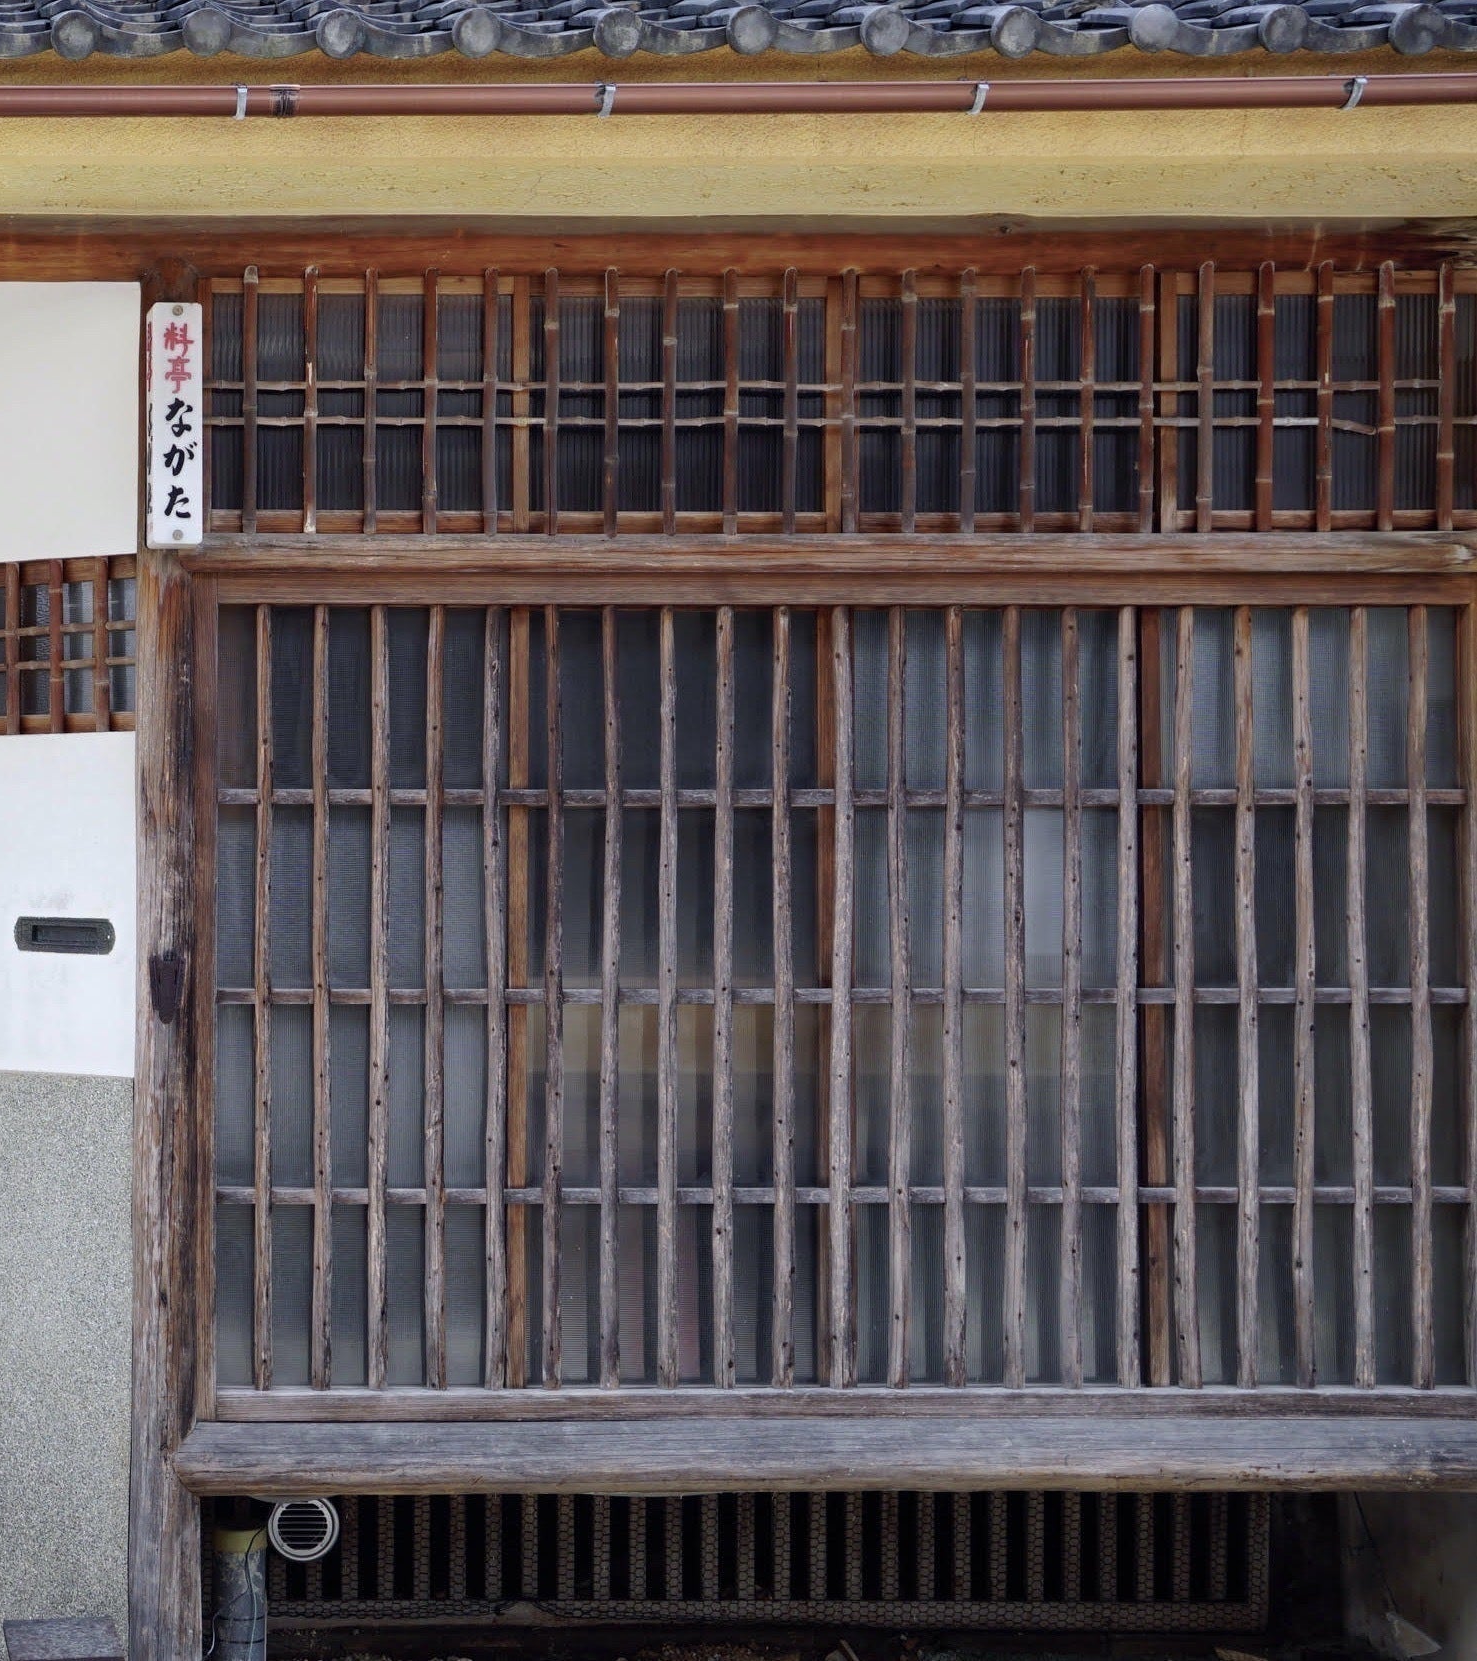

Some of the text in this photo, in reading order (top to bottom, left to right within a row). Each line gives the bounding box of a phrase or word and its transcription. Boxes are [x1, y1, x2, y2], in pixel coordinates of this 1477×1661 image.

[163, 321, 198, 519] 料亭ながた
